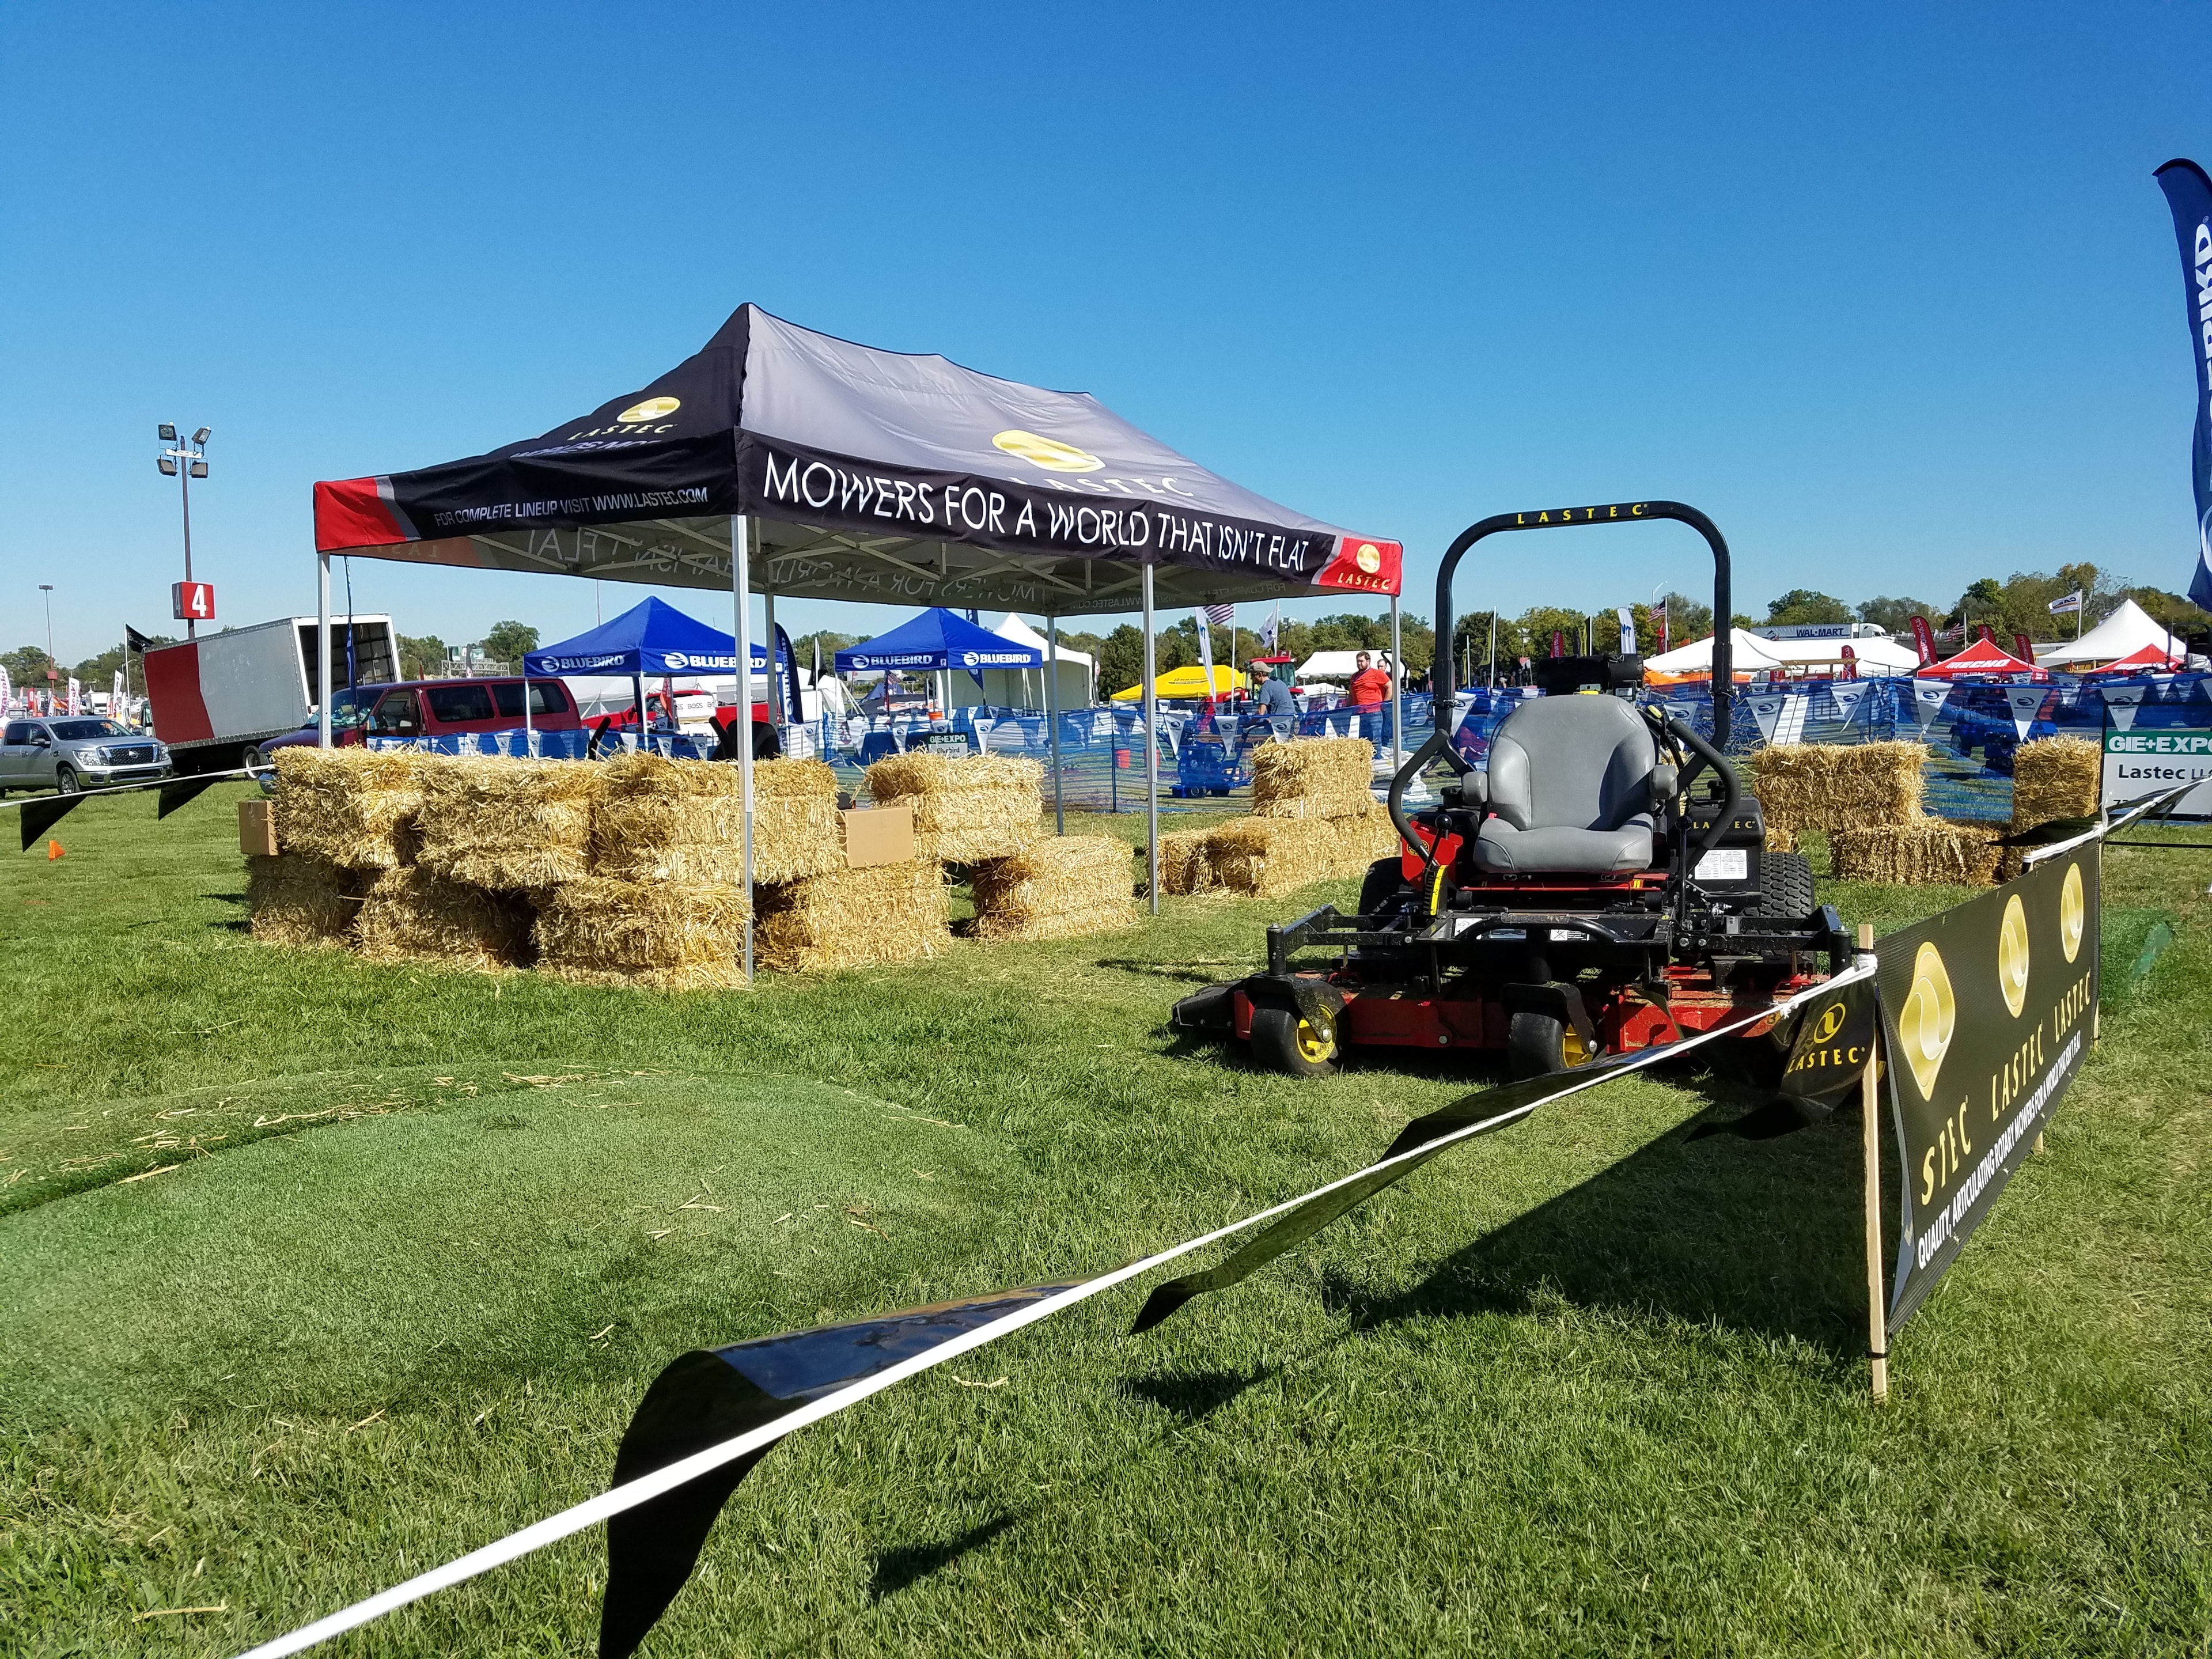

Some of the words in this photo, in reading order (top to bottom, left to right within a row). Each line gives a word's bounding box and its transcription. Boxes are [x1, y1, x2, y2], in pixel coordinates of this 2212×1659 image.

[567, 425, 674, 441] LASTEC
[434, 512, 455, 527] FOR
[455, 503, 511, 524] COMPLETE
[516, 501, 557, 518] LINEUP
[560, 498, 589, 514] VISIT
[592, 487, 708, 511] WWW.LASTEC.COM
[764, 452, 933, 522] MOWERS
[945, 486, 1005, 533] FOR
[1016, 499, 1036, 537] A
[1047, 502, 1149, 546] WORLD
[1157, 513, 1213, 555] THAT
[1218, 525, 1265, 564] ISN'T
[1268, 536, 1309, 571] FLAT
[1517, 503, 1645, 524] LASTEC
[1338, 573, 1391, 590] LASTEC
[176, 584, 181, 616] 4
[192, 585, 207, 618] 4
[560, 655, 624, 669] BLUEBIRD
[690, 656, 767, 668] BLUEBRD
[871, 654, 933, 666] BLUEBIRD
[980, 654, 1031, 663] BLUEBIRD
[1957, 658, 2010, 669] ECHO
[929, 734, 966, 743] GIE+EXPO
[2109, 736, 2212, 752] GIE+EXP
[2118, 764, 2185, 779] Lastec
[1694, 821, 1753, 829] LAEC
[2055, 971, 2091, 1043] LASTEC
[1787, 1047, 1861, 1074] LASTEC
[1993, 1024, 2044, 1122] LASTEC
[1918, 1205, 1952, 1270] QUALITY,
[1952, 1149, 1995, 1227] ARTICULATING
[1994, 1122, 2015, 1169] ROTARY
[2014, 1096, 2035, 1142] MOWERS
[2035, 1085, 2044, 1115] FOR
[2043, 1081, 2047, 1103] A
[2046, 1062, 2059, 1097] WORLD
[2058, 1050, 2067, 1078] THAT
[1921, 1102, 1971, 1205] STEC
